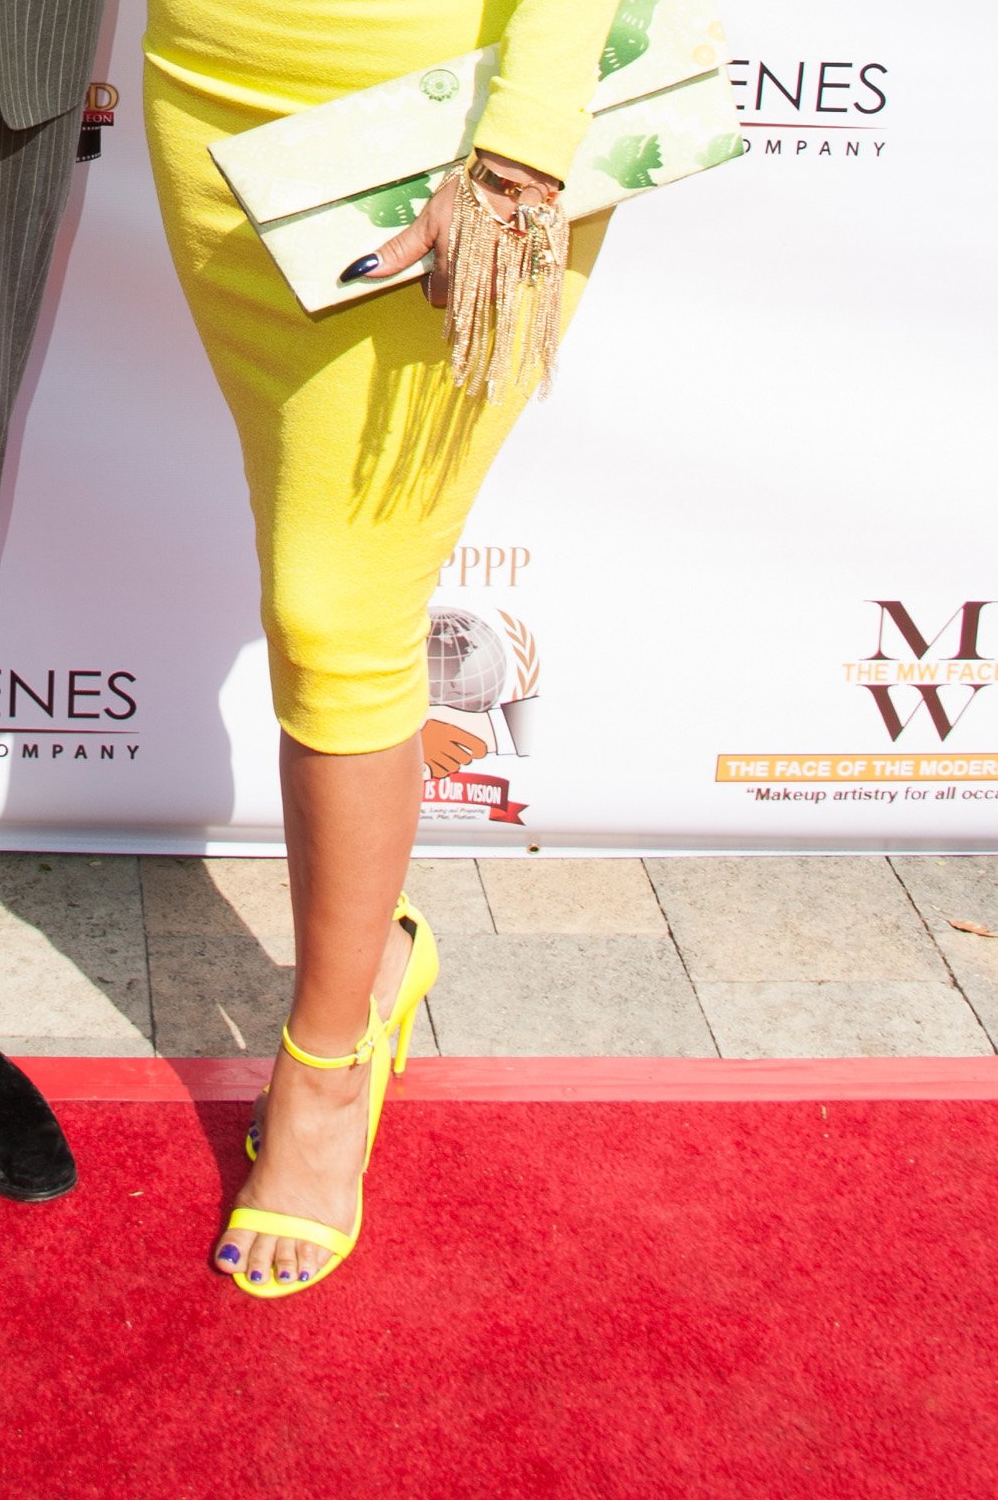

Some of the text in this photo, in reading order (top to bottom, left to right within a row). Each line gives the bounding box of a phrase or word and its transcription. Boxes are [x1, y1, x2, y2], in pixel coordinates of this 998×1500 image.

[842, 662, 998, 682] THE MW FAC
[726, 760, 770, 777] THE
[774, 760, 831, 777] FACE
[836, 760, 868, 777] OF
[872, 760, 915, 777] THE
[833, 787, 898, 804] artistry
[904, 786, 929, 800] for
[935, 786, 957, 800] all
